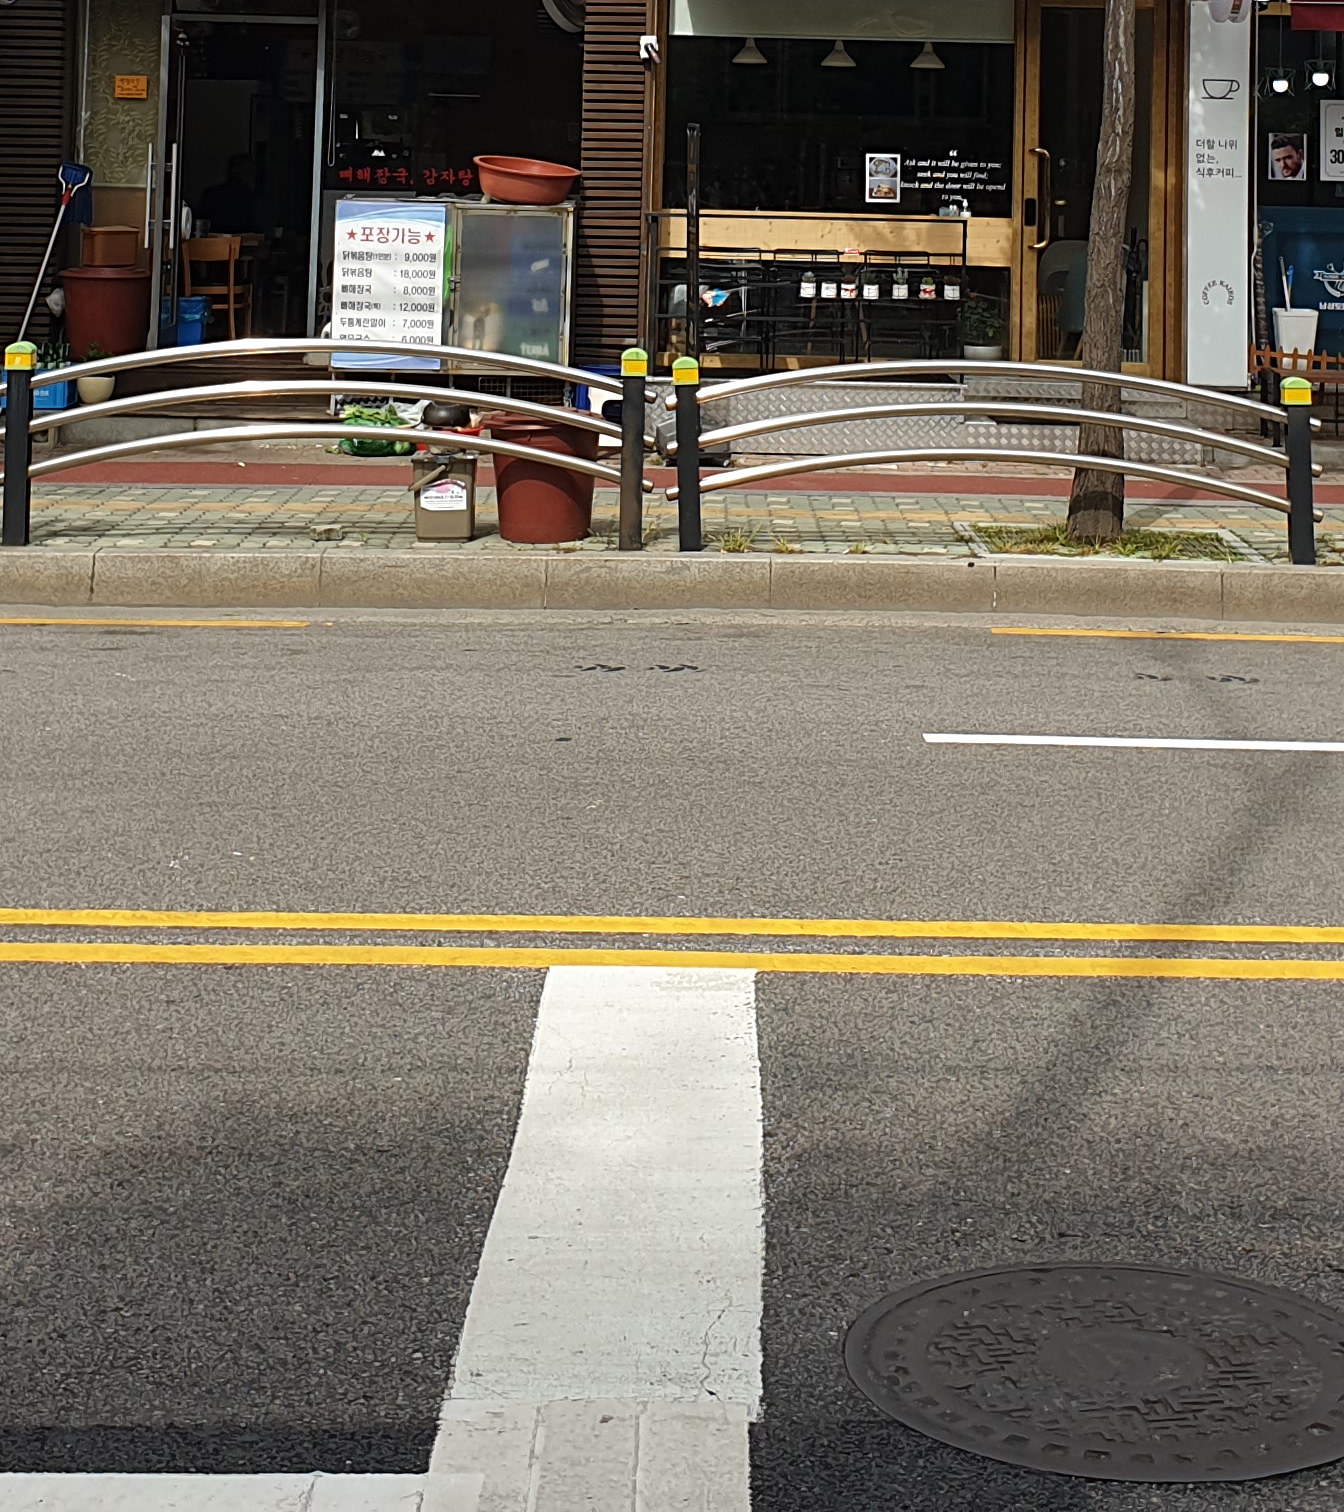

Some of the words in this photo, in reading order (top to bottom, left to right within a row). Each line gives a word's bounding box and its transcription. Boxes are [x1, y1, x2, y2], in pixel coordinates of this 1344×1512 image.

[1195, 139, 1215, 150] 더할
[1218, 139, 1238, 150] 나위
[423, 168, 474, 186] 감자탕
[360, 226, 422, 245] 포장가능
[404, 252, 437, 263] 9,000원
[400, 269, 436, 280] 18,000원
[403, 285, 436, 296] 8,000원
[399, 302, 436, 313] 12,000원
[402, 319, 435, 329] 7,000원
